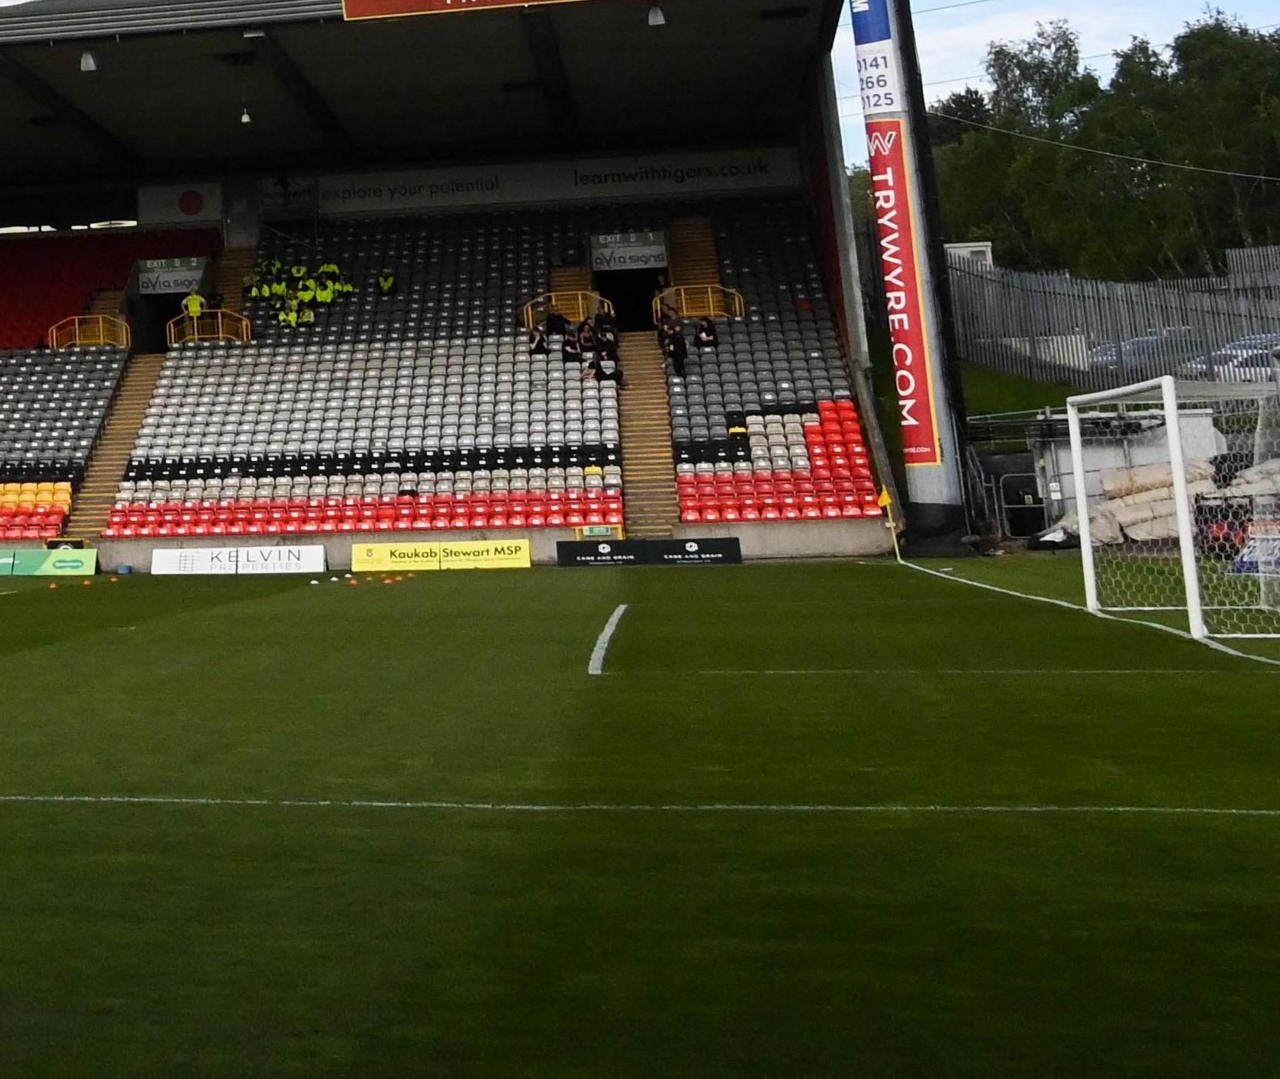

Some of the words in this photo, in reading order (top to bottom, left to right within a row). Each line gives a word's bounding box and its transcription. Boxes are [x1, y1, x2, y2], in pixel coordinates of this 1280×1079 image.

[388, 184, 424, 200] your
[429, 175, 500, 197] potential
[872, 167, 920, 428] TRYWYRE.COM
[210, 549, 301, 563] KELVIN
[389, 548, 438, 559] Kaukab
[442, 547, 490, 558] Stewart
[494, 545, 522, 556] MSP
[210, 562, 302, 571] PROPERTIES
